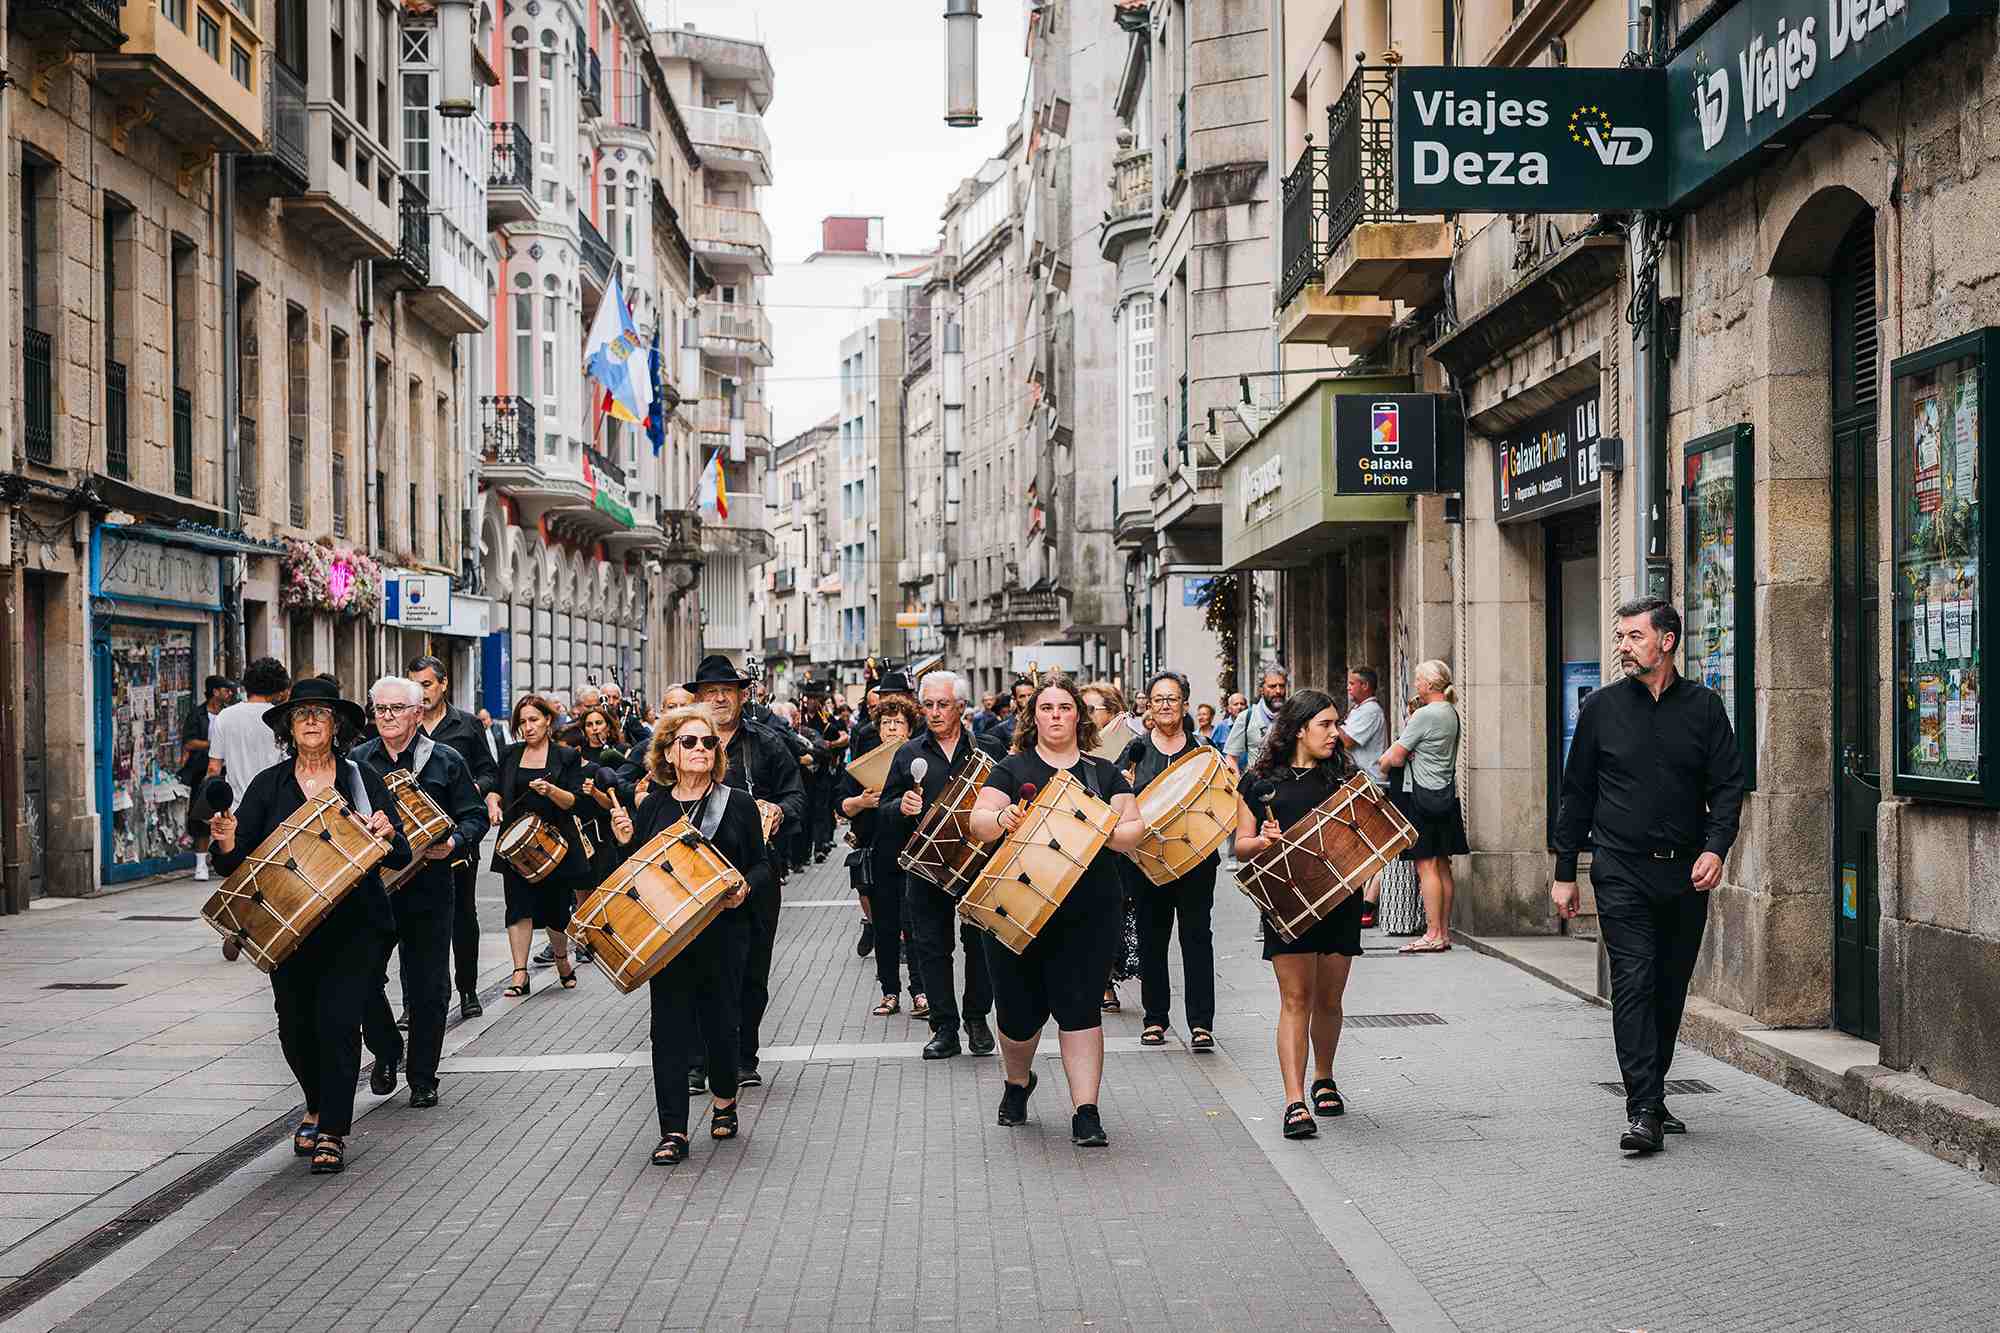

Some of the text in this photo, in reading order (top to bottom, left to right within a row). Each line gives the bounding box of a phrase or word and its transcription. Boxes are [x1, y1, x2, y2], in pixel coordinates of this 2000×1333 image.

[1738, 16, 1817, 119] Viajes
[1413, 90, 1549, 135] Viajes
[1413, 141, 1549, 185] Deza
[1359, 457, 1413, 470] Galaxia
[1510, 430, 1566, 477] Galaxia Phone
[1363, 472, 1408, 485] Phone
